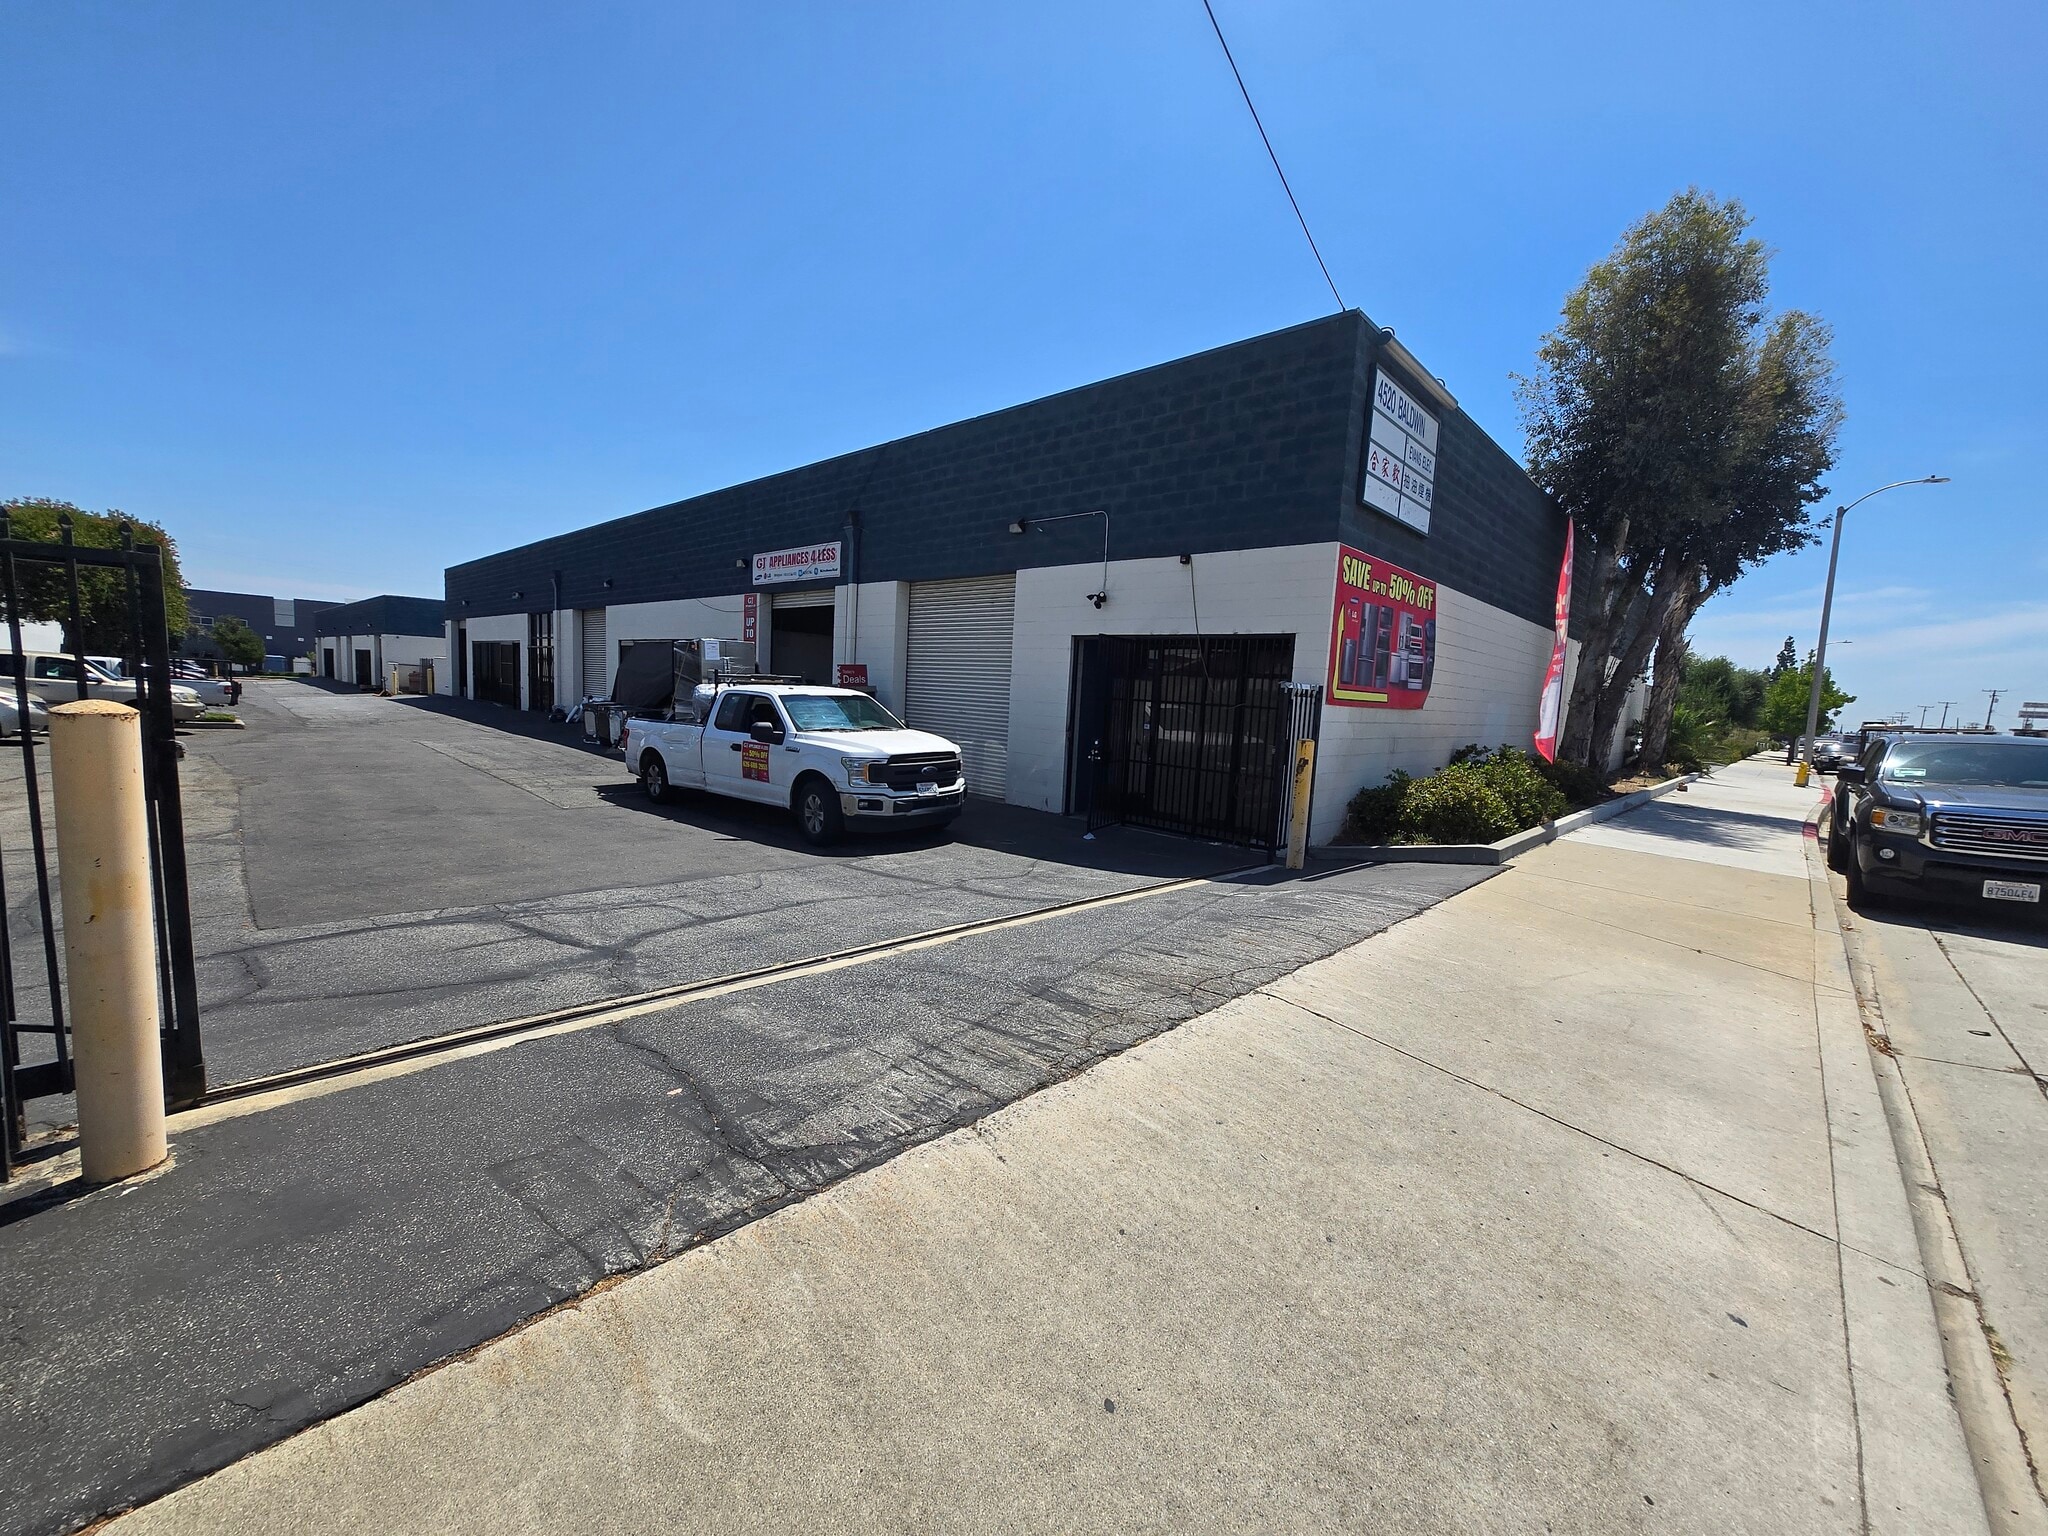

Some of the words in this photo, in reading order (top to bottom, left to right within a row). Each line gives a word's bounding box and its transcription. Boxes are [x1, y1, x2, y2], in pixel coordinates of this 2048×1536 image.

[1378, 379, 1396, 412] 4520
[1398, 396, 1426, 439] BALDWIN
[1409, 445, 1422, 467] EVANS
[769, 551, 809, 568] APPLIANCES
[810, 550, 816, 563] 4
[817, 547, 836, 563] LESS
[1342, 555, 1372, 591] SAVE
[1372, 579, 1380, 593] UP
[1389, 573, 1415, 606] 50%
[1416, 584, 1434, 611] OFF
[746, 617, 754, 626] UP
[745, 629, 754, 638] TO
[843, 675, 866, 684] Deals
[1983, 828, 2048, 843] GMC
